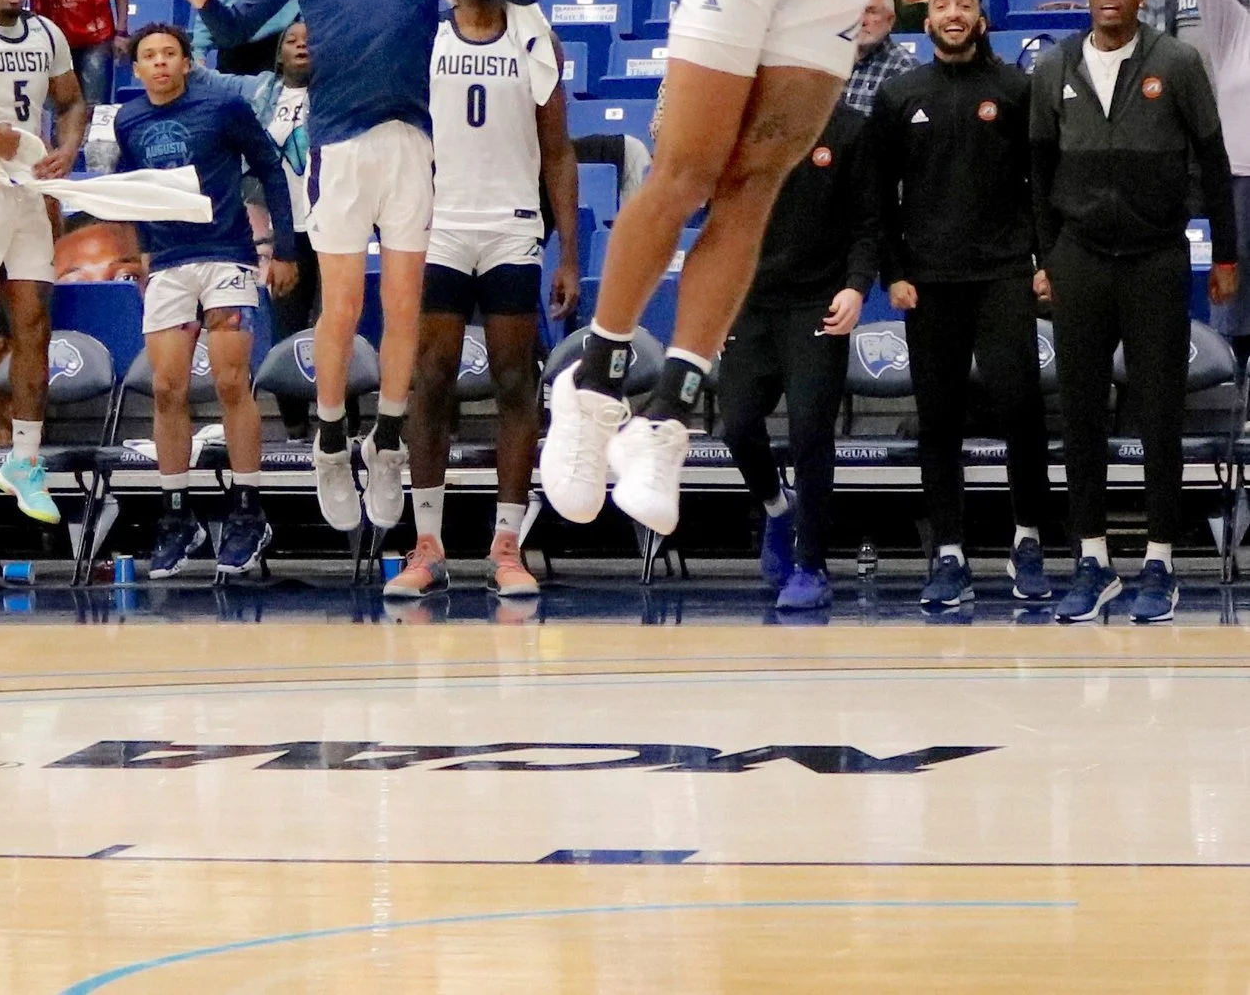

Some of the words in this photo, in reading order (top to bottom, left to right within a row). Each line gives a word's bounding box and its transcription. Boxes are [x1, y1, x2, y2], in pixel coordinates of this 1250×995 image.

[436, 54, 519, 79] AUGUSTA
[13, 80, 31, 122] 5
[467, 83, 486, 128] 0
[145, 141, 188, 159] AUGUSTA
[835, 448, 888, 458] AGUARS
